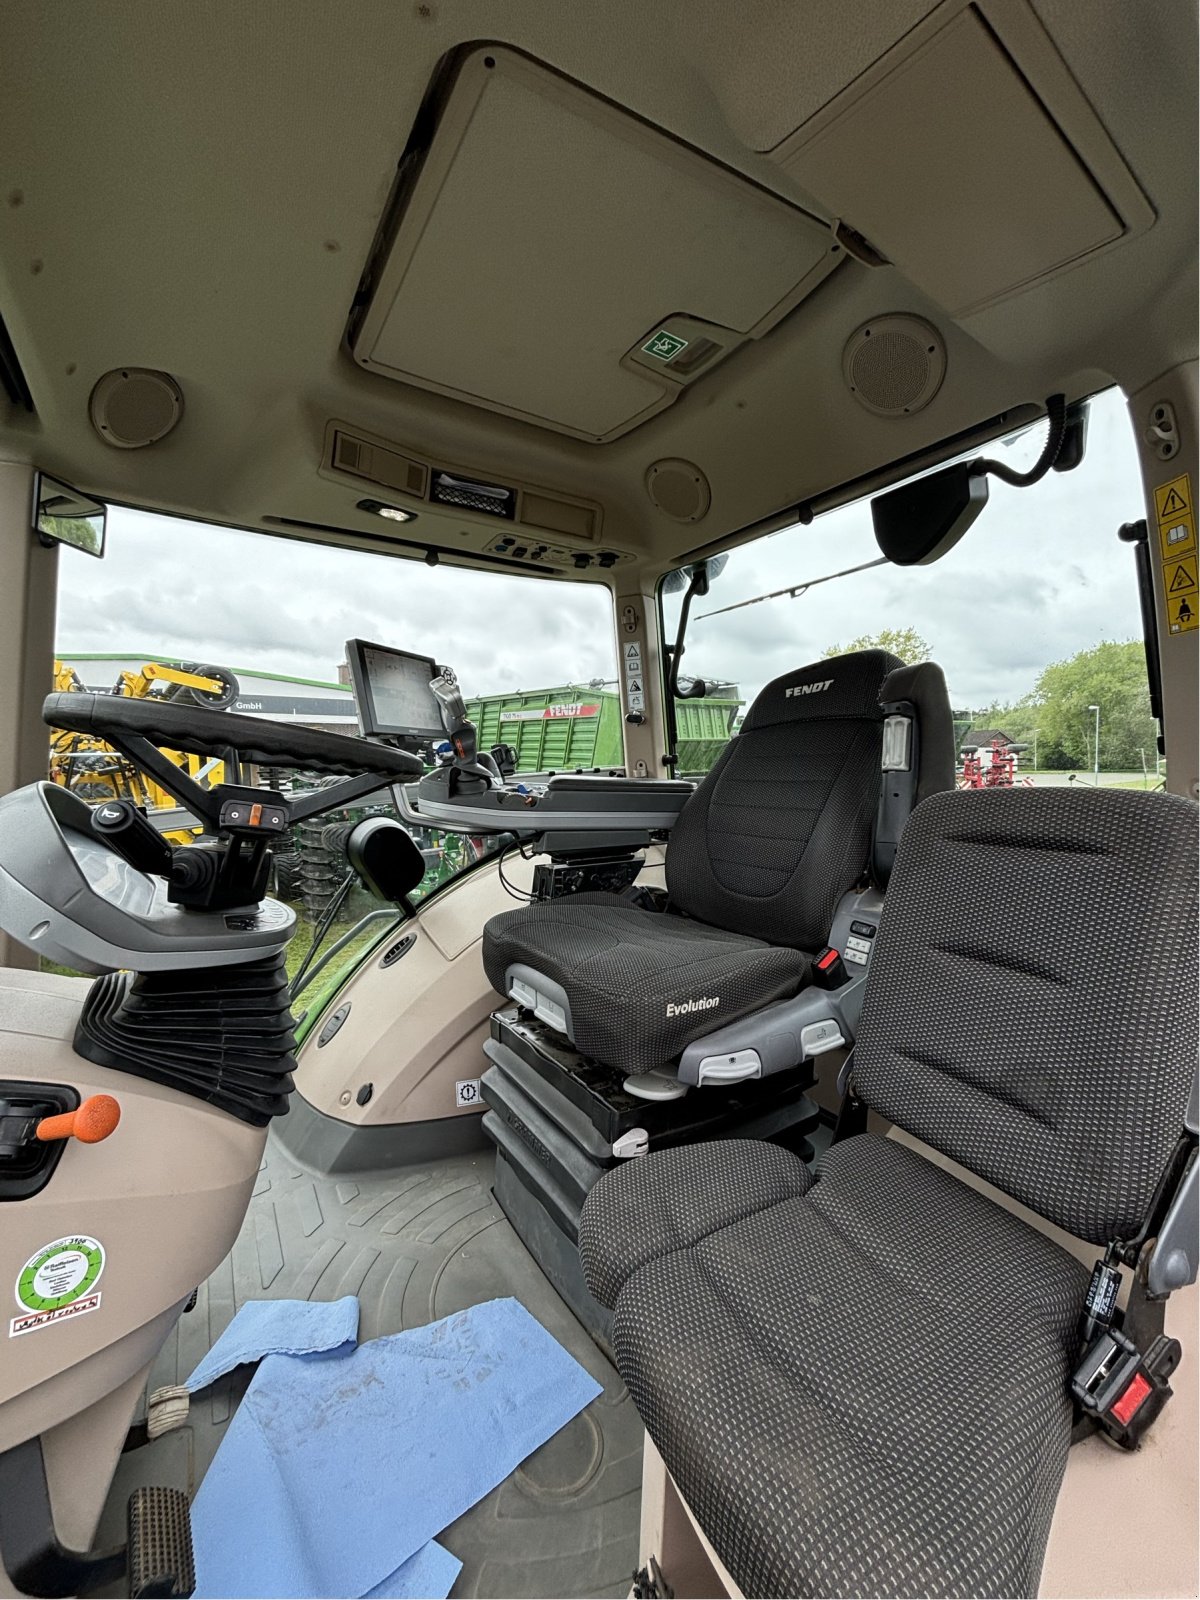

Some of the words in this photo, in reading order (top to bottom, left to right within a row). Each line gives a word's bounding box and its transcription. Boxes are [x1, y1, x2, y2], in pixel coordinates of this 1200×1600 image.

[785, 679, 834, 698] FENDT
[550, 703, 583, 716] FENDT
[666, 997, 720, 1017] Evolution
